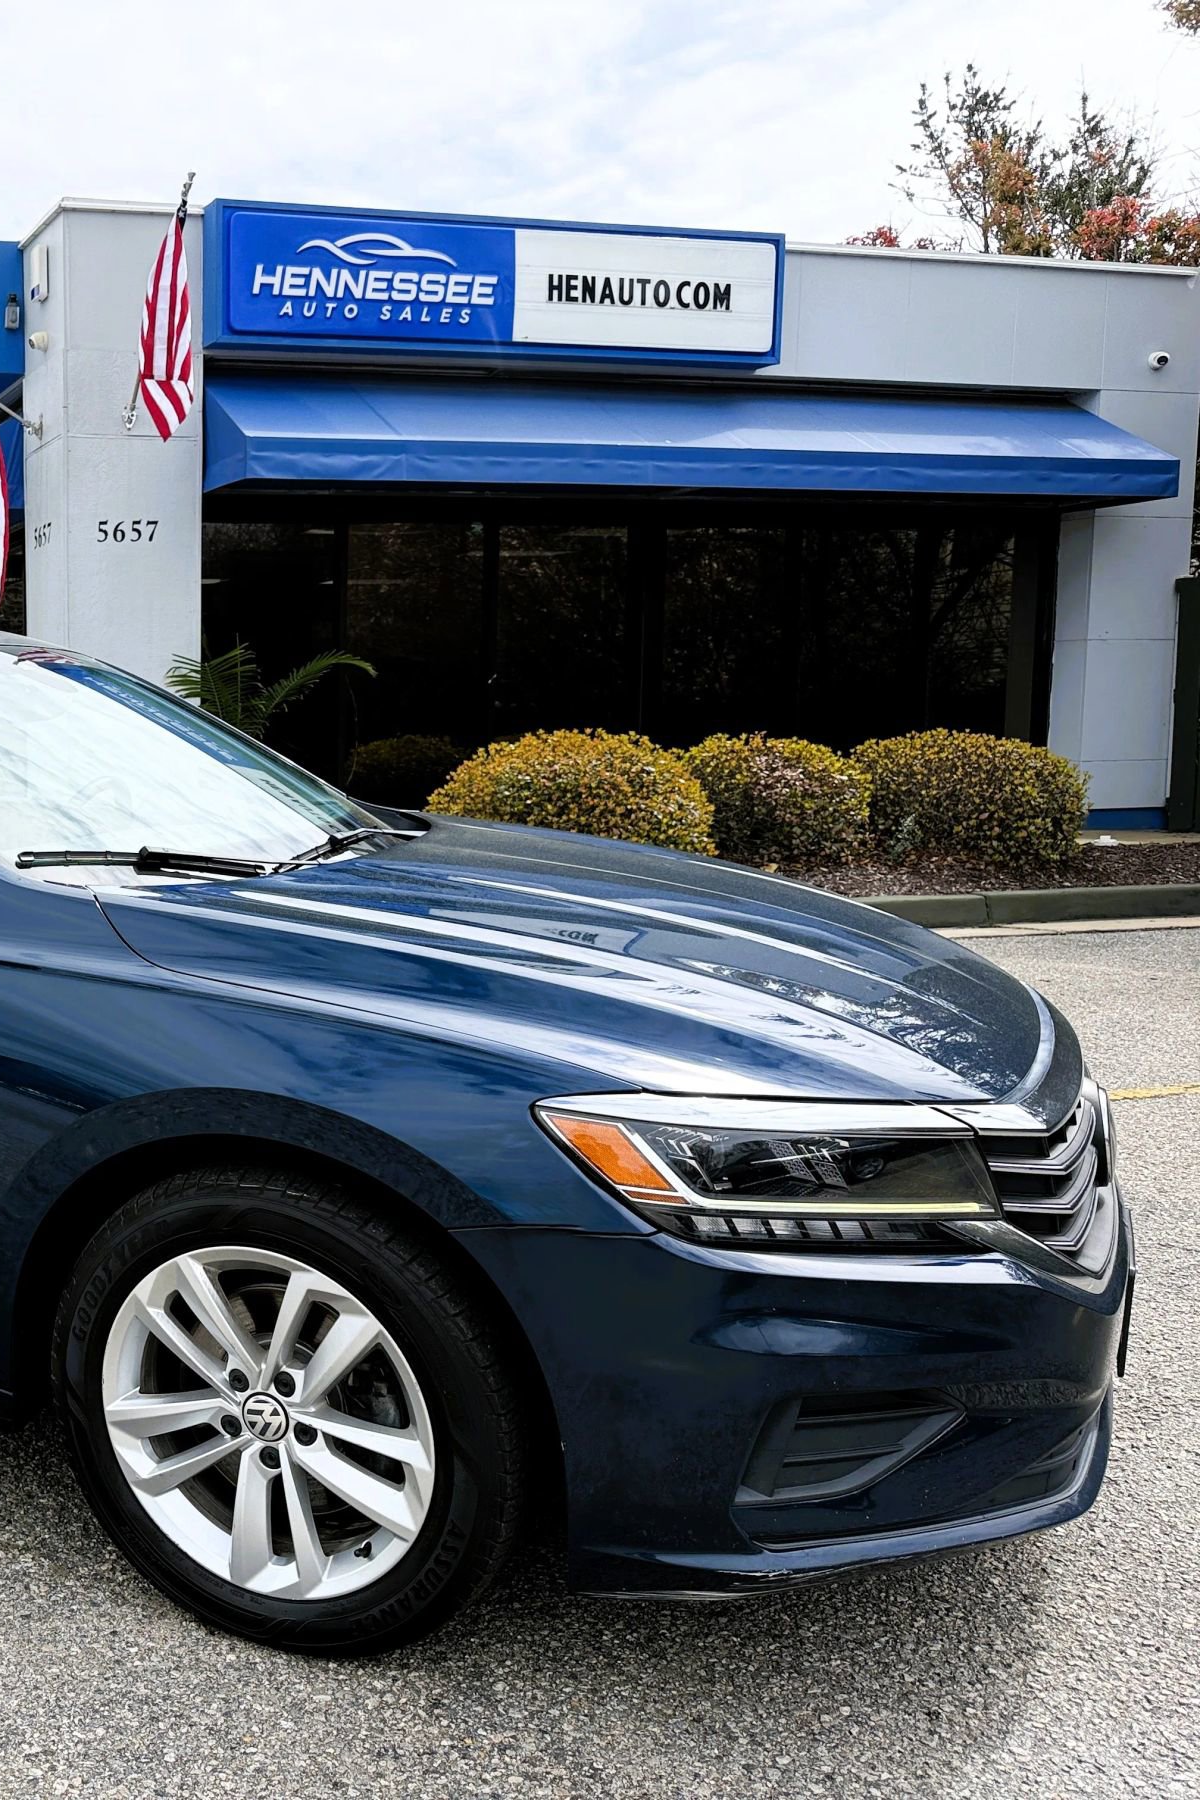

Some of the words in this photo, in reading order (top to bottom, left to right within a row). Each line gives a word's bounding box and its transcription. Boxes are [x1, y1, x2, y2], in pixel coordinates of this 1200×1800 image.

[252, 264, 499, 305] HENNESSEE
[279, 301, 359, 319] AUTO
[379, 305, 472, 324] SALES
[34, 522, 52, 549] 5657
[97, 519, 160, 543] 5657
